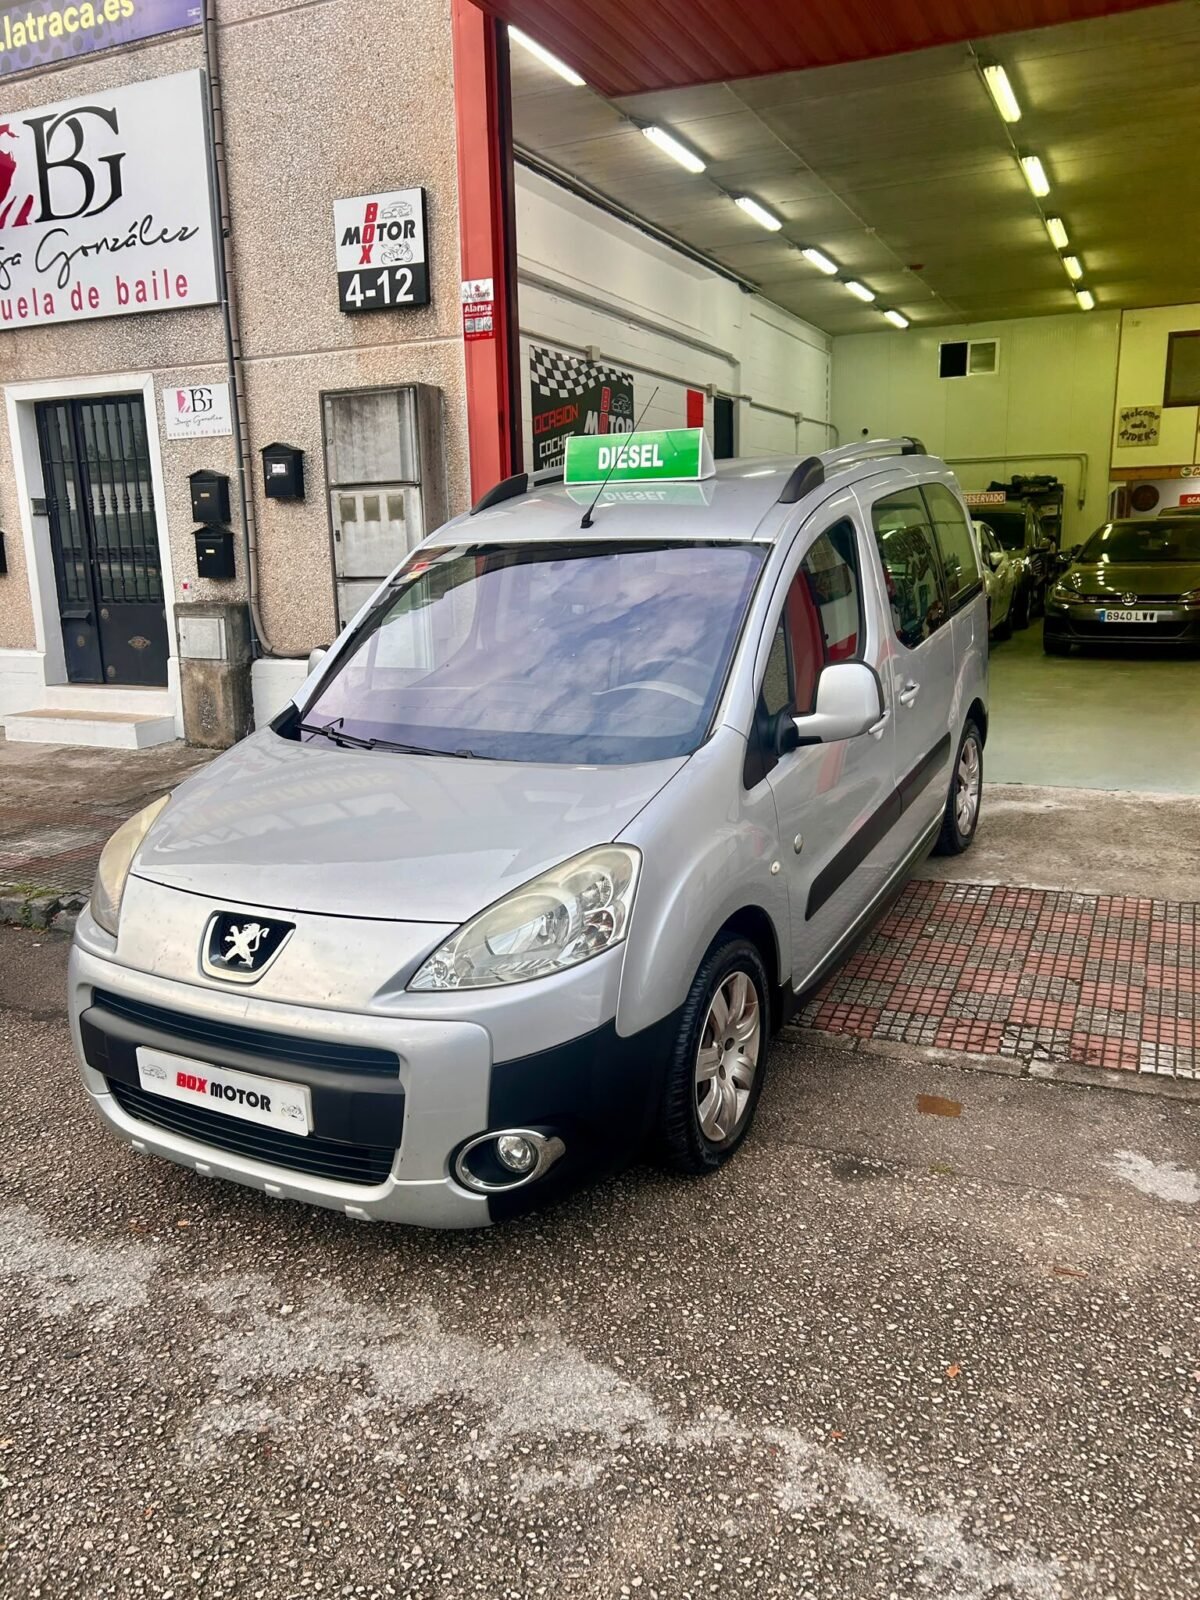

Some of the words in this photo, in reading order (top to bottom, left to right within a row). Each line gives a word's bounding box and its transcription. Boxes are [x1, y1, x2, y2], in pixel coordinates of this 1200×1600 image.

[22, 106, 126, 223] BG
[341, 219, 415, 246] MOTOR
[359, 202, 378, 264] BOX
[35, 214, 200, 289] González
[70, 281, 100, 311] de
[116, 269, 188, 305] baile
[345, 267, 414, 307] 4-12
[464, 304, 492, 313] Alarma
[188, 387, 213, 412] BG
[1121, 407, 1160, 421] Welcome
[534, 403, 579, 435] OCASION
[598, 444, 663, 470] DIESEL
[1107, 611, 1132, 621] 6940
[176, 1071, 208, 1094] BOX
[210, 1082, 271, 1112] MOTOR
